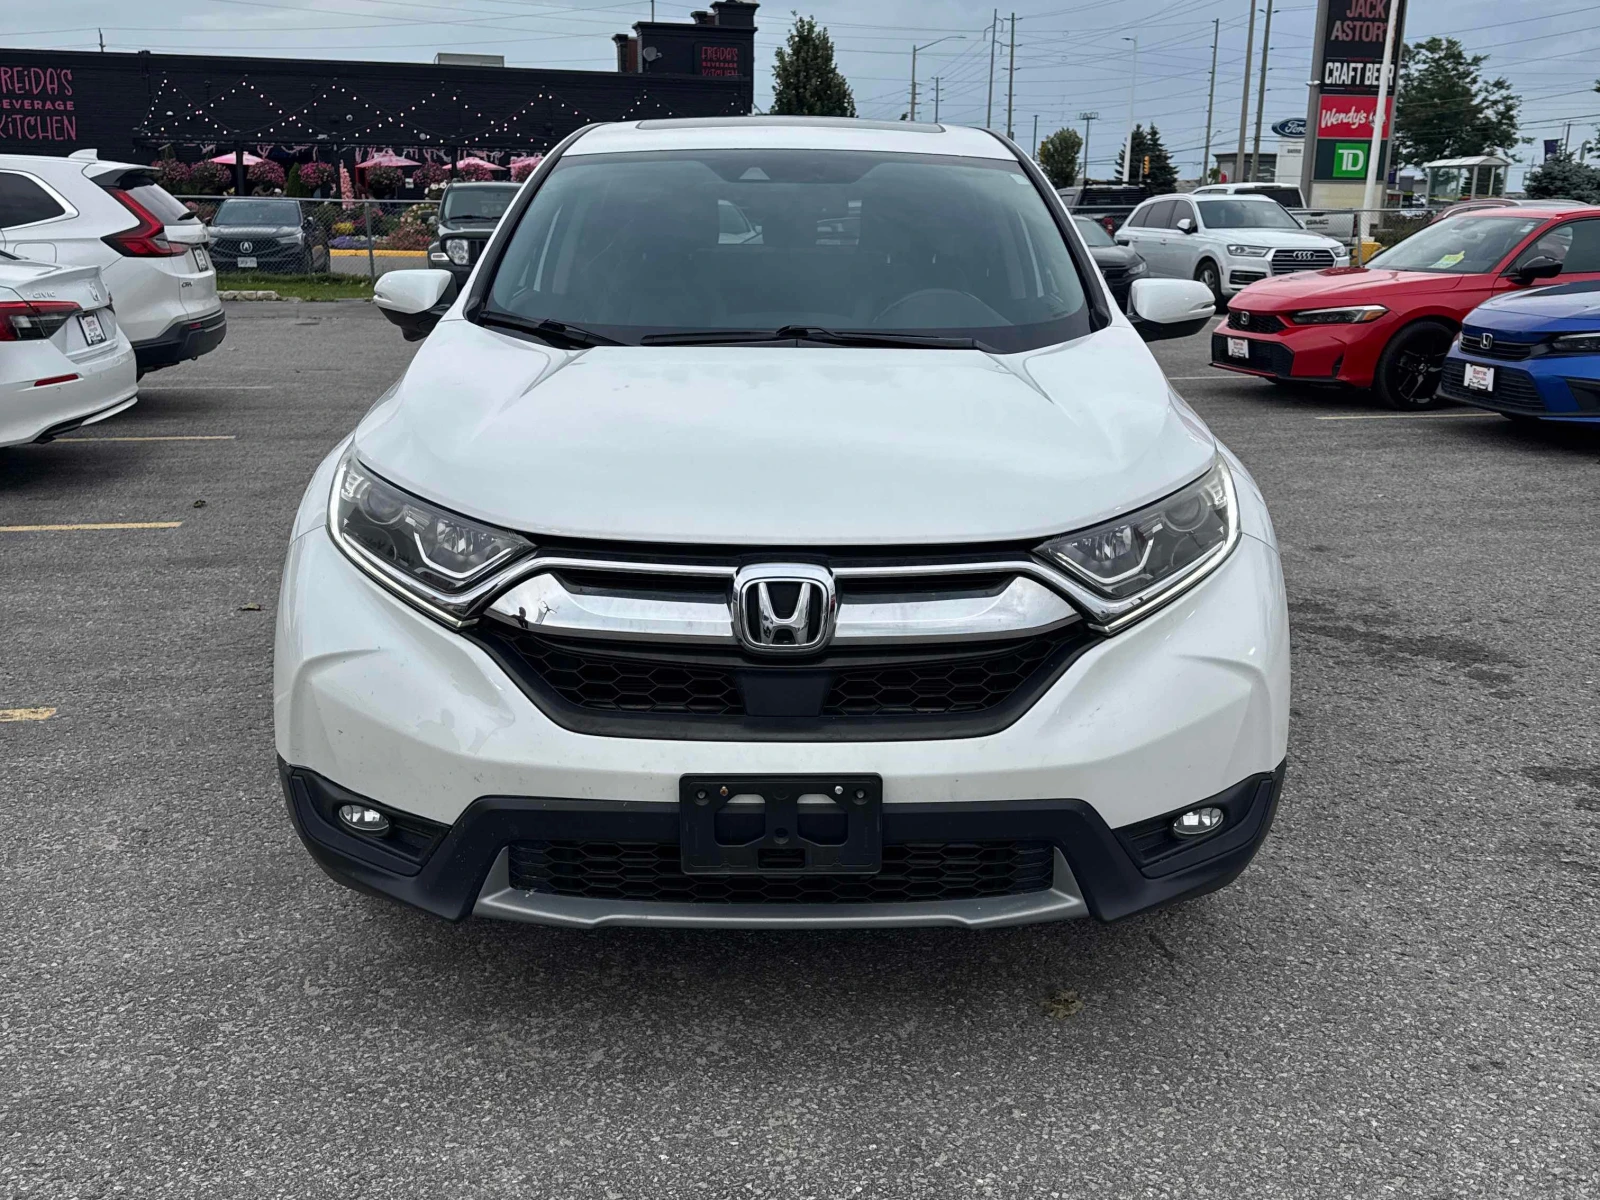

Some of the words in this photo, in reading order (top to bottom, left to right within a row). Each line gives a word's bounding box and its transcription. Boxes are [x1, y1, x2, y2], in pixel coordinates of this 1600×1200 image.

[1346, 0, 1386, 18] JACK
[1330, 20, 1388, 42] ASTOR'
[1324, 62, 1364, 85] CRAFT
[1364, 63, 1395, 86] BER
[0, 99, 75, 110] EVERAGE
[1320, 106, 1367, 129] Wendy's
[1338, 149, 1365, 171] TD
